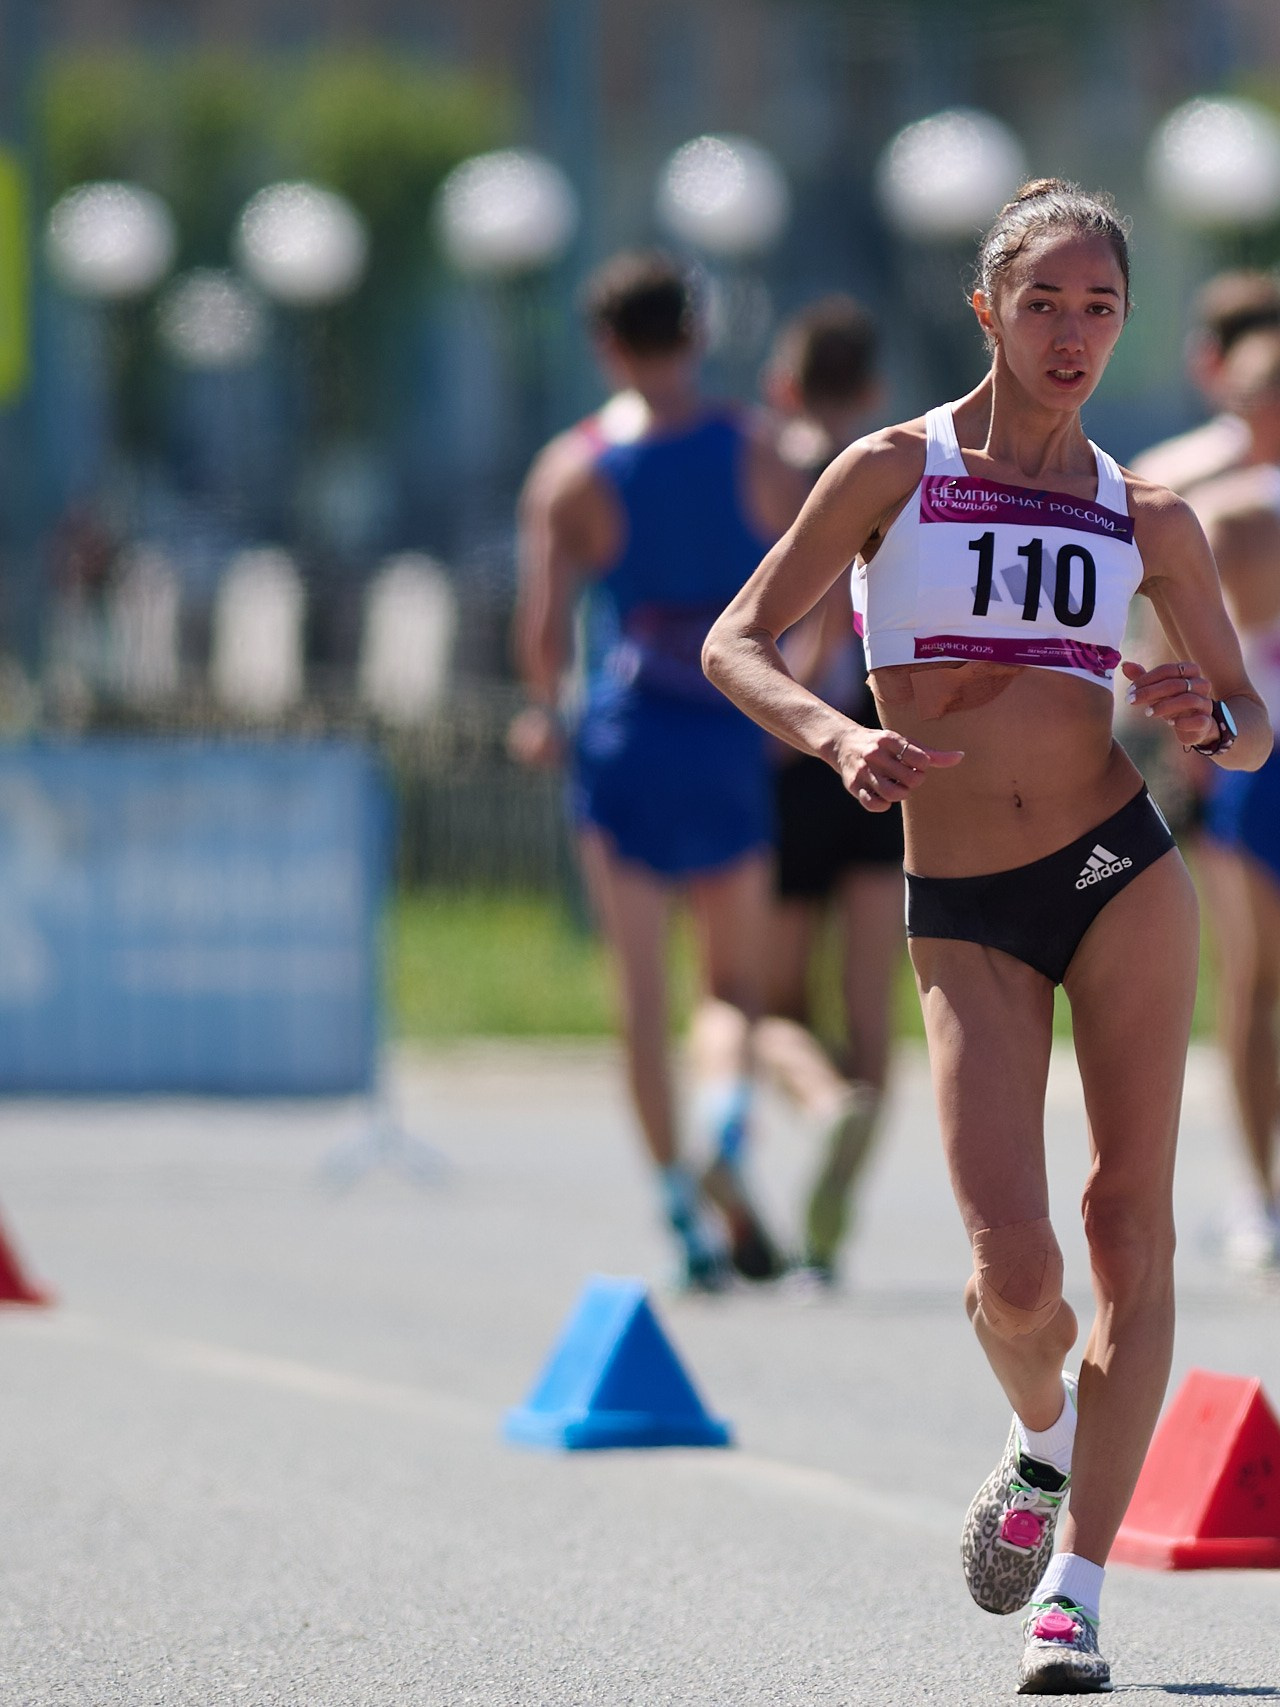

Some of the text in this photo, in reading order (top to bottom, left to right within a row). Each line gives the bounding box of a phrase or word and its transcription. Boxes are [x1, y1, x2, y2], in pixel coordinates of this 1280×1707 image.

[931, 500, 998, 512] по ходьбе
[931, 487, 1115, 531] ЧЕМПИОНАТ РОССИИ
[968, 531, 1097, 628] 110
[970, 644, 994, 654] 2025
[1075, 857, 1133, 890] adidas
